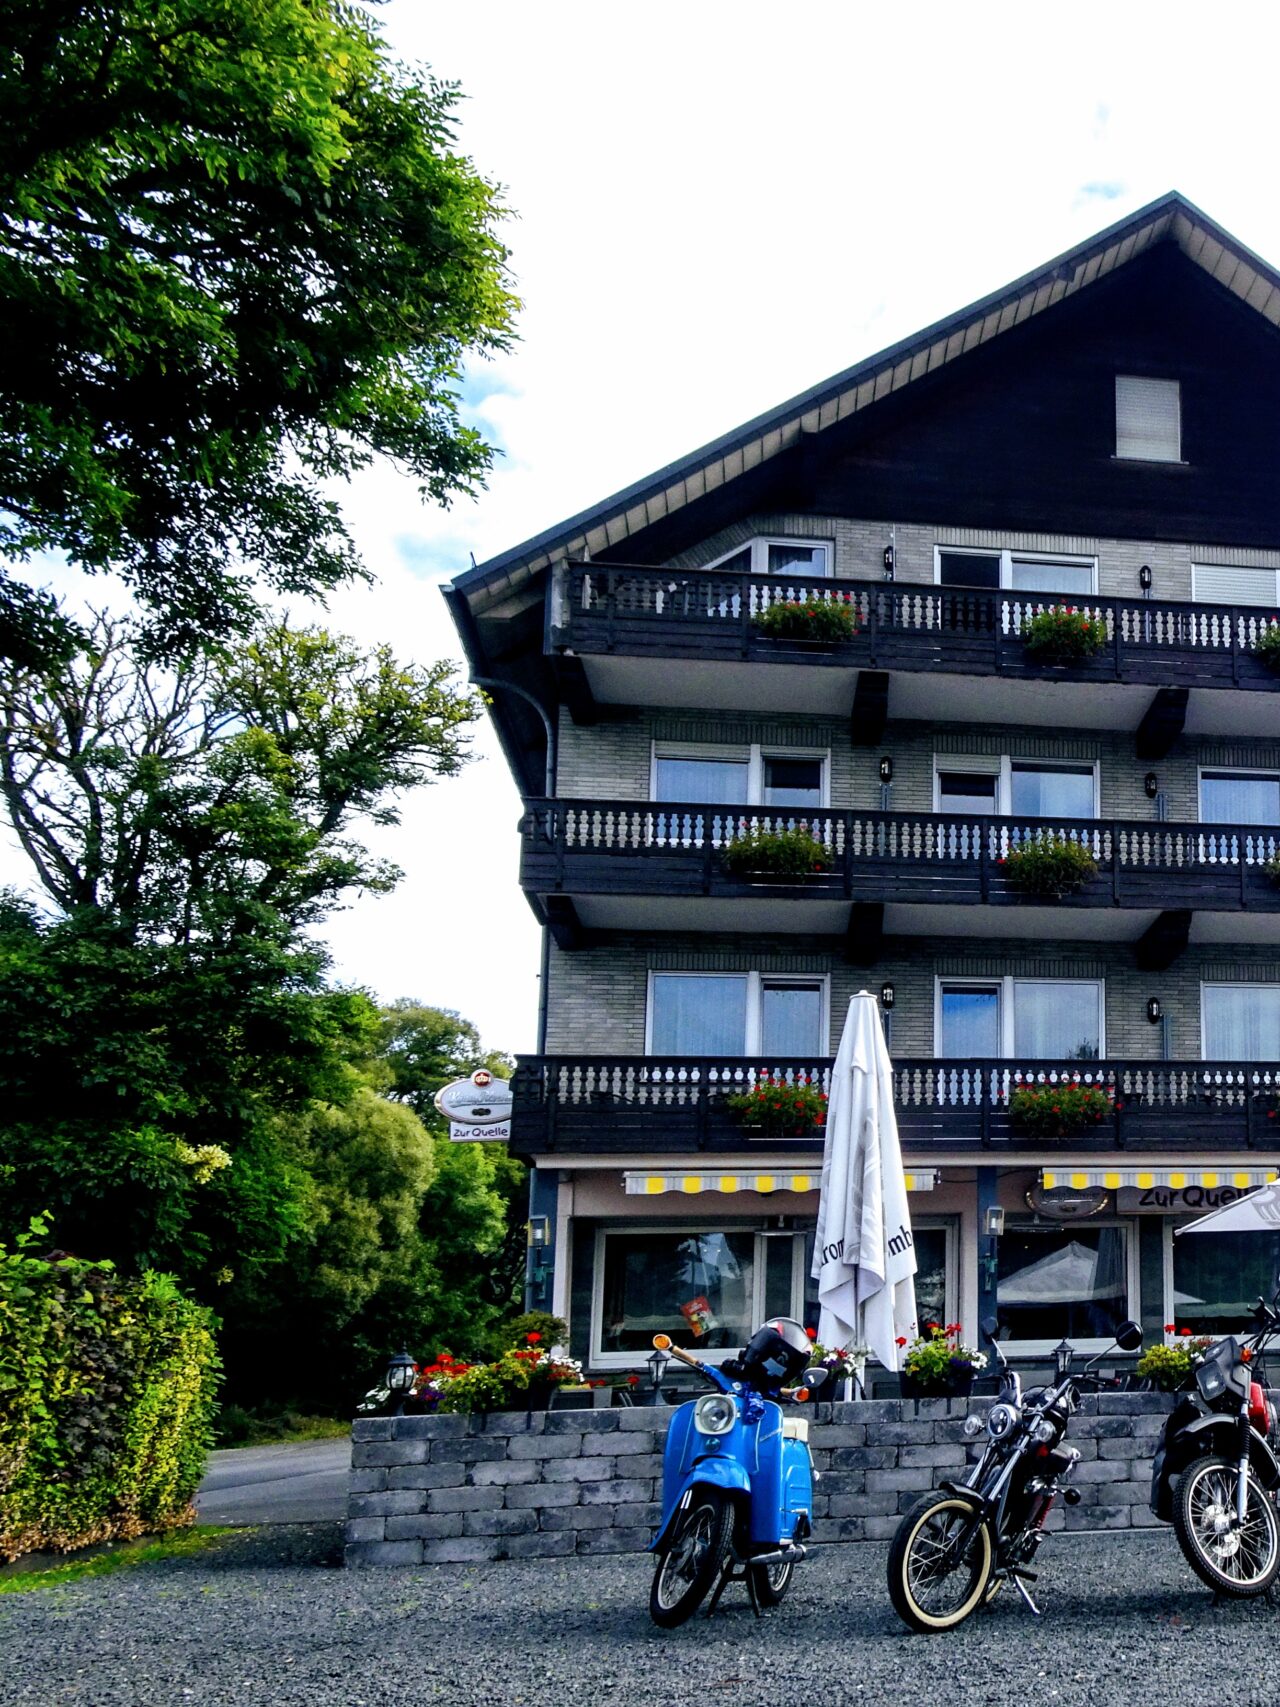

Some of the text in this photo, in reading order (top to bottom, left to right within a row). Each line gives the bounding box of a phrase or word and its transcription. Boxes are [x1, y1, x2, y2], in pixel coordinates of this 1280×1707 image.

[453, 1127, 509, 1137] Zur Quelle
[1139, 1188, 1179, 1207] Zur
